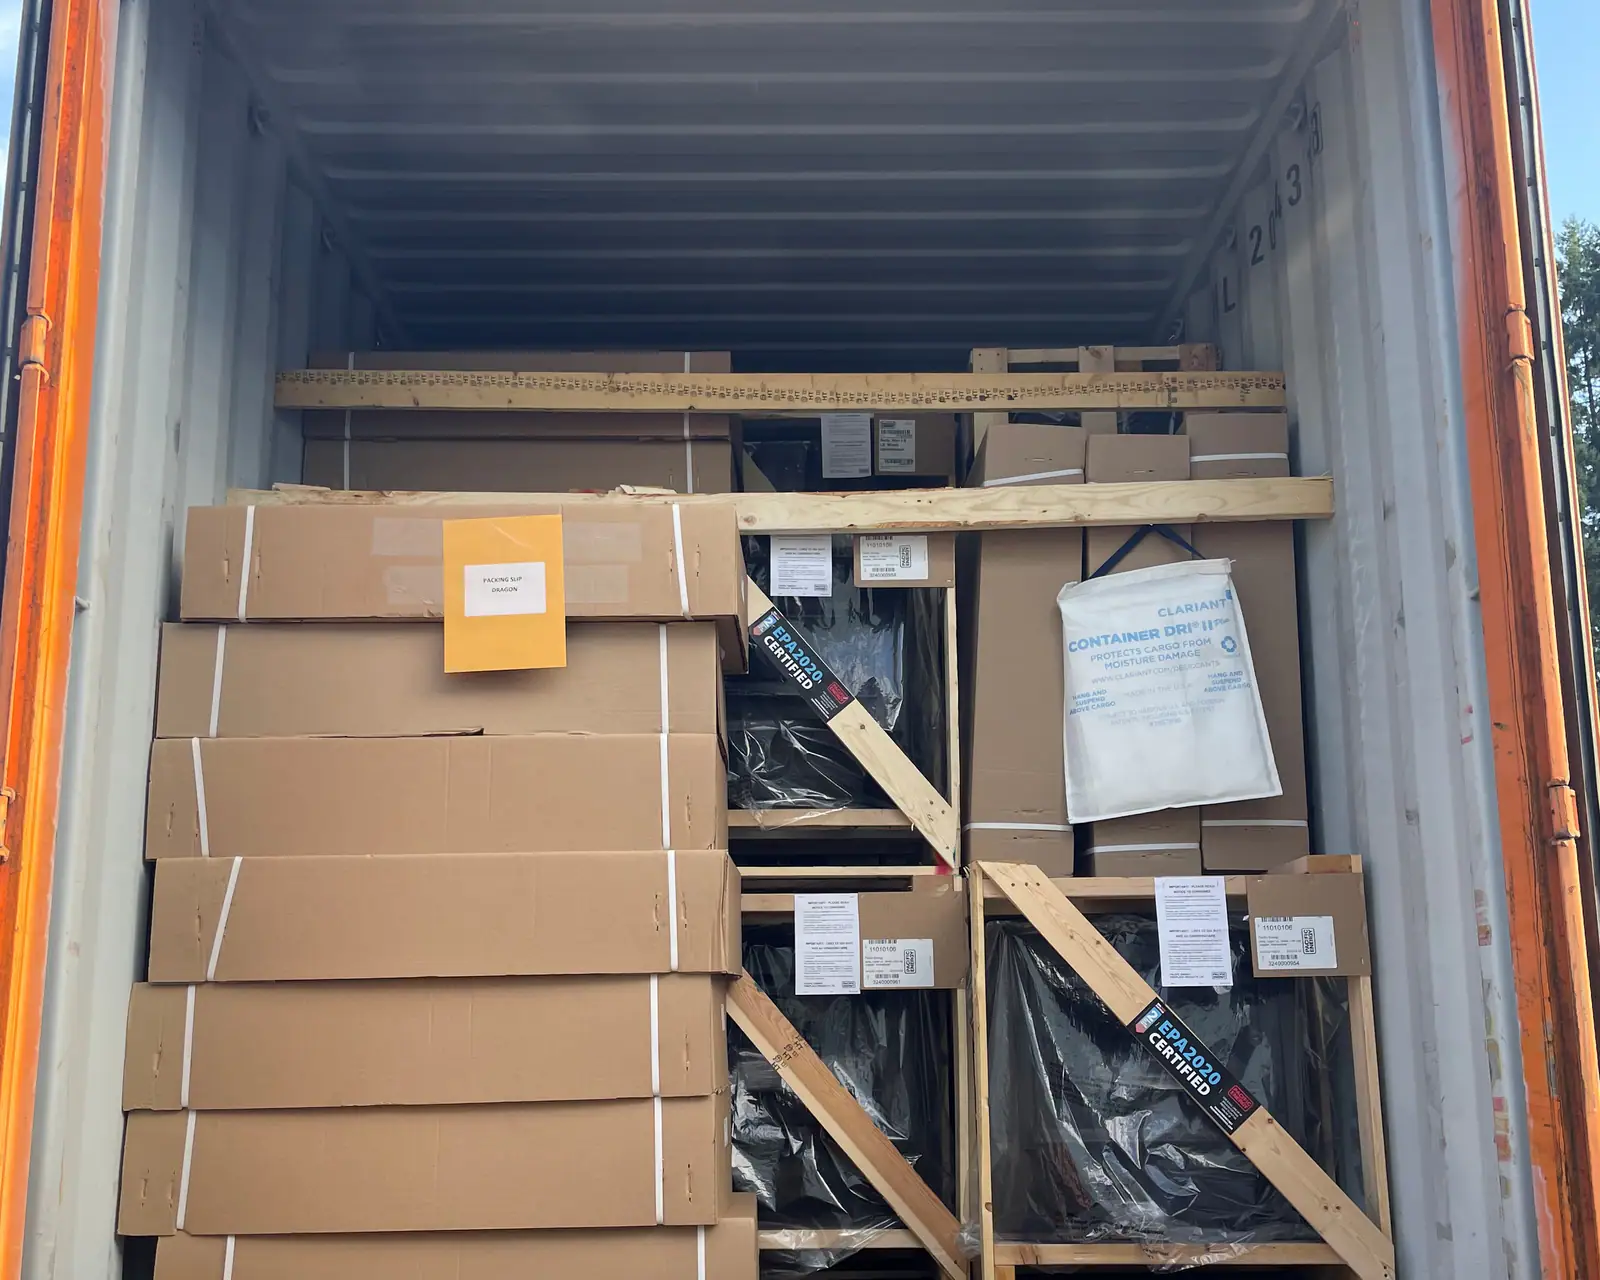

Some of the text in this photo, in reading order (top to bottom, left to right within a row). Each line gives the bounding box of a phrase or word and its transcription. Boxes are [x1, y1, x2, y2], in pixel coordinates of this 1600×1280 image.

[1158, 598, 1227, 617] CLARIANT
[1068, 629, 1160, 653] CONTAINER
[1090, 638, 1212, 662] PROTECTS CARGO FROM
[764, 635, 813, 690] CERTIFIED
[772, 626, 823, 681] EPA2020
[1104, 650, 1200, 670] MOISTURE DAMAGE
[1072, 691, 1090, 700] HANG
[1204, 685, 1227, 693] ABOVE
[1069, 705, 1090, 715] ABOVE
[1091, 701, 1116, 711] CARGO
[1075, 696, 1105, 706] SUSPEND
[1158, 1020, 1221, 1085] EPA2020
[1148, 1032, 1210, 1096] CERTIFIED
